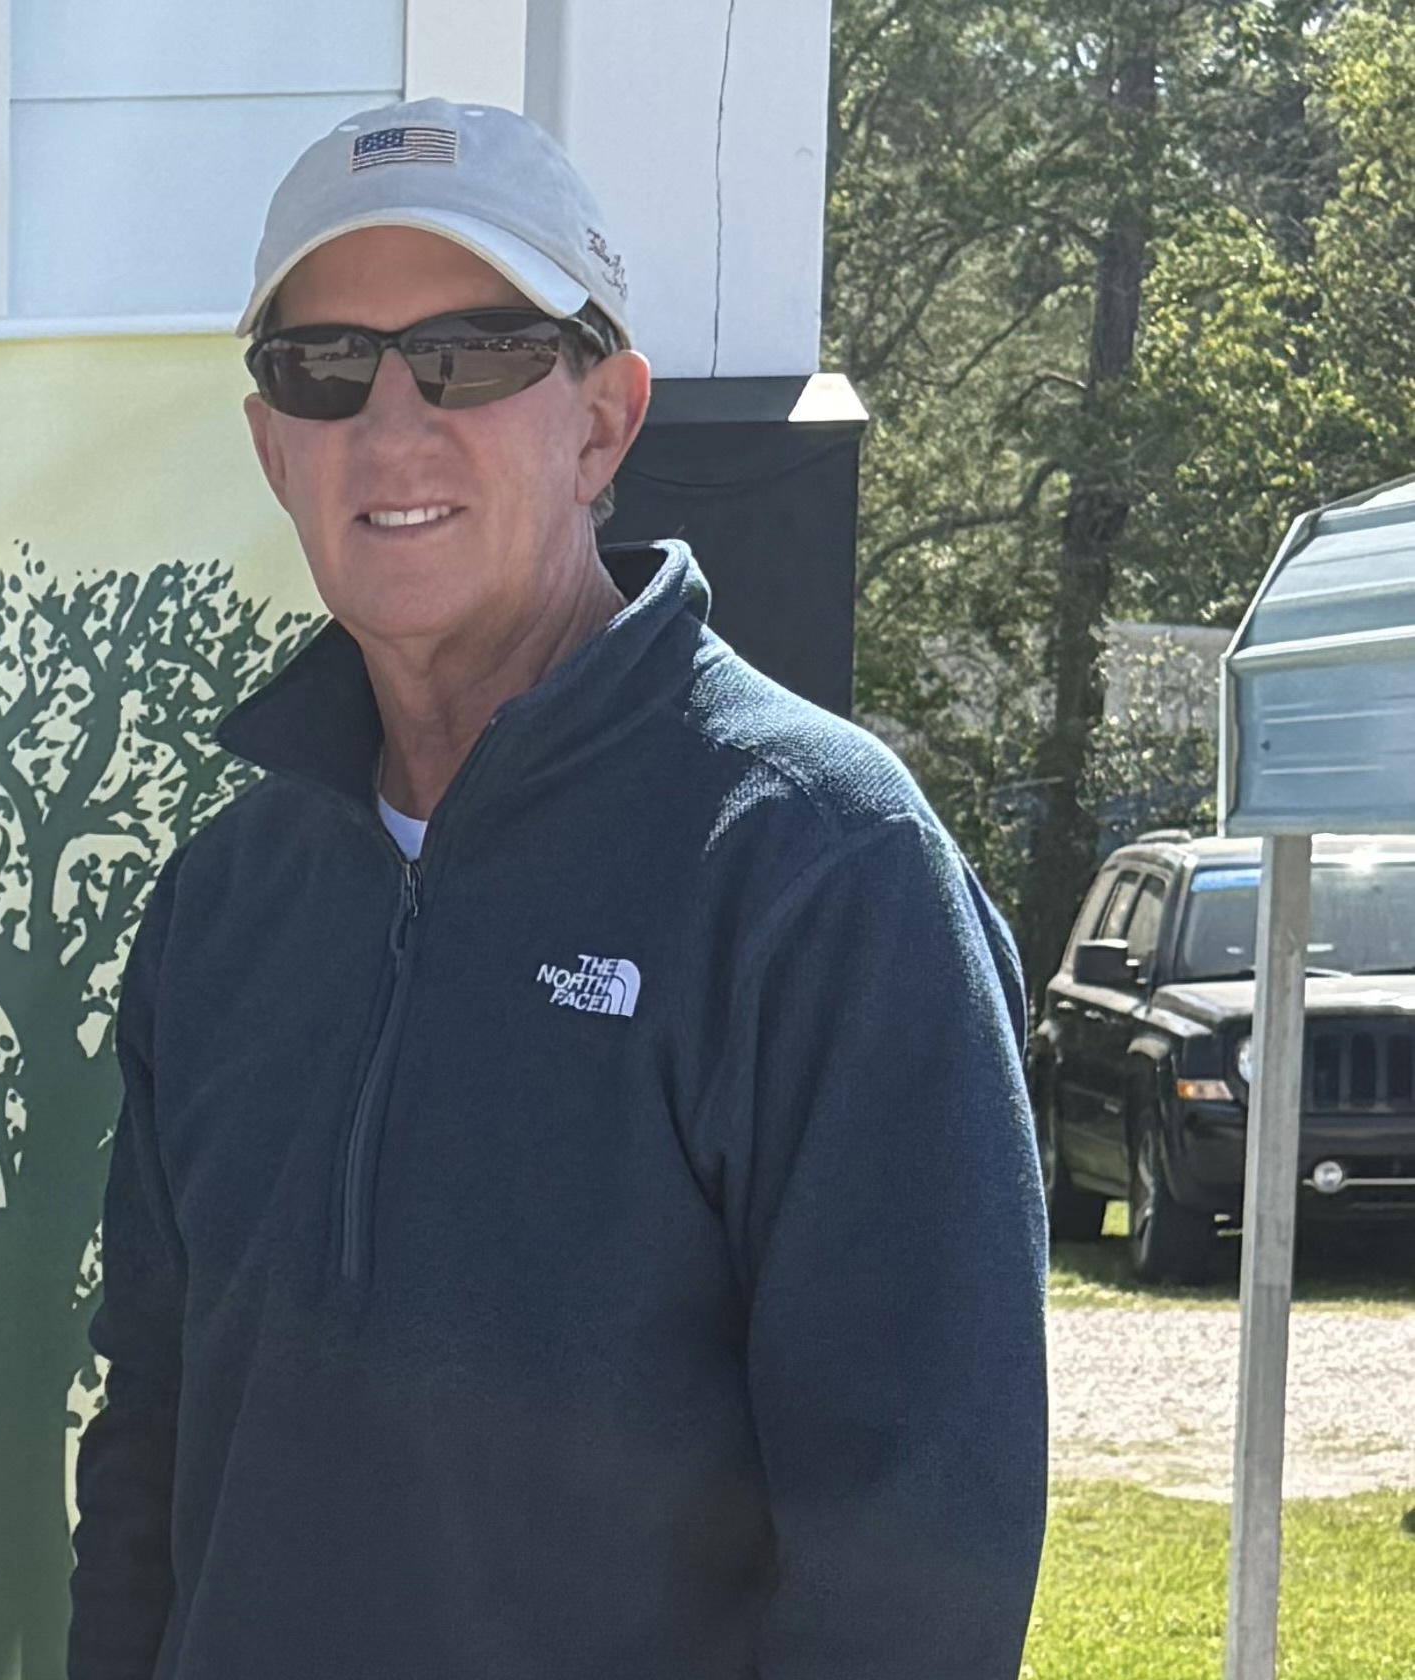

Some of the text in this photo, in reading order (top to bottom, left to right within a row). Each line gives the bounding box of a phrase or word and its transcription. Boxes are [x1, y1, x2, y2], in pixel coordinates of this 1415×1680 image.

[577, 953, 618, 976] THE
[535, 963, 610, 996] NORTH
[549, 987, 606, 1013] FACE
